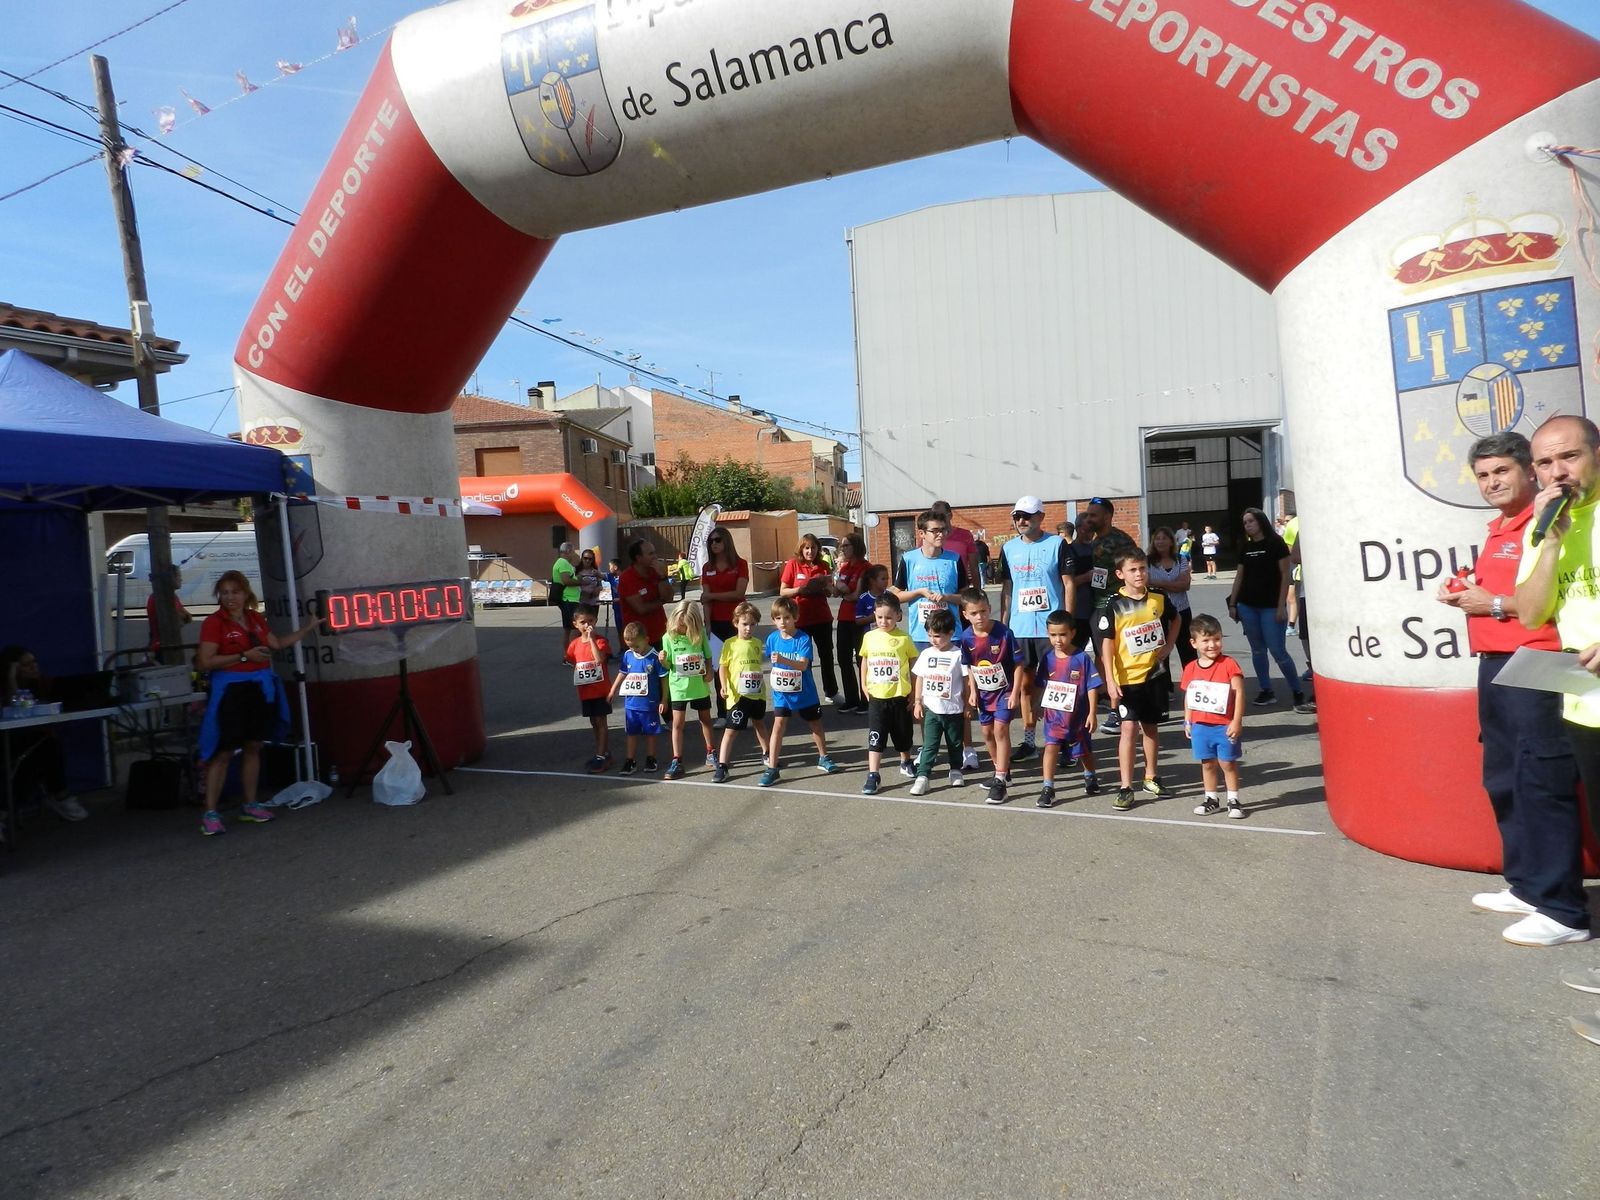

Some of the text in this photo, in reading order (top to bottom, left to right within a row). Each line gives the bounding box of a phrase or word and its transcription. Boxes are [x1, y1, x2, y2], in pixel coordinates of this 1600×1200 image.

[1229, 0, 1480, 119] ESTROS
[622, 86, 657, 121] de
[665, 12, 894, 108] Salamanca
[247, 98, 400, 369] CON EL DEPORTE
[1022, 594, 1043, 606] 440
[1134, 631, 1158, 647] 546
[1347, 625, 1382, 659] de
[682, 661, 701, 672] 555
[873, 666, 893, 677] 560
[578, 669, 597, 680] 552
[978, 674, 999, 685] 566
[625, 681, 642, 690] 548
[776, 677, 796, 687] 554
[926, 681, 944, 692] 565
[1047, 691, 1068, 704] 567
